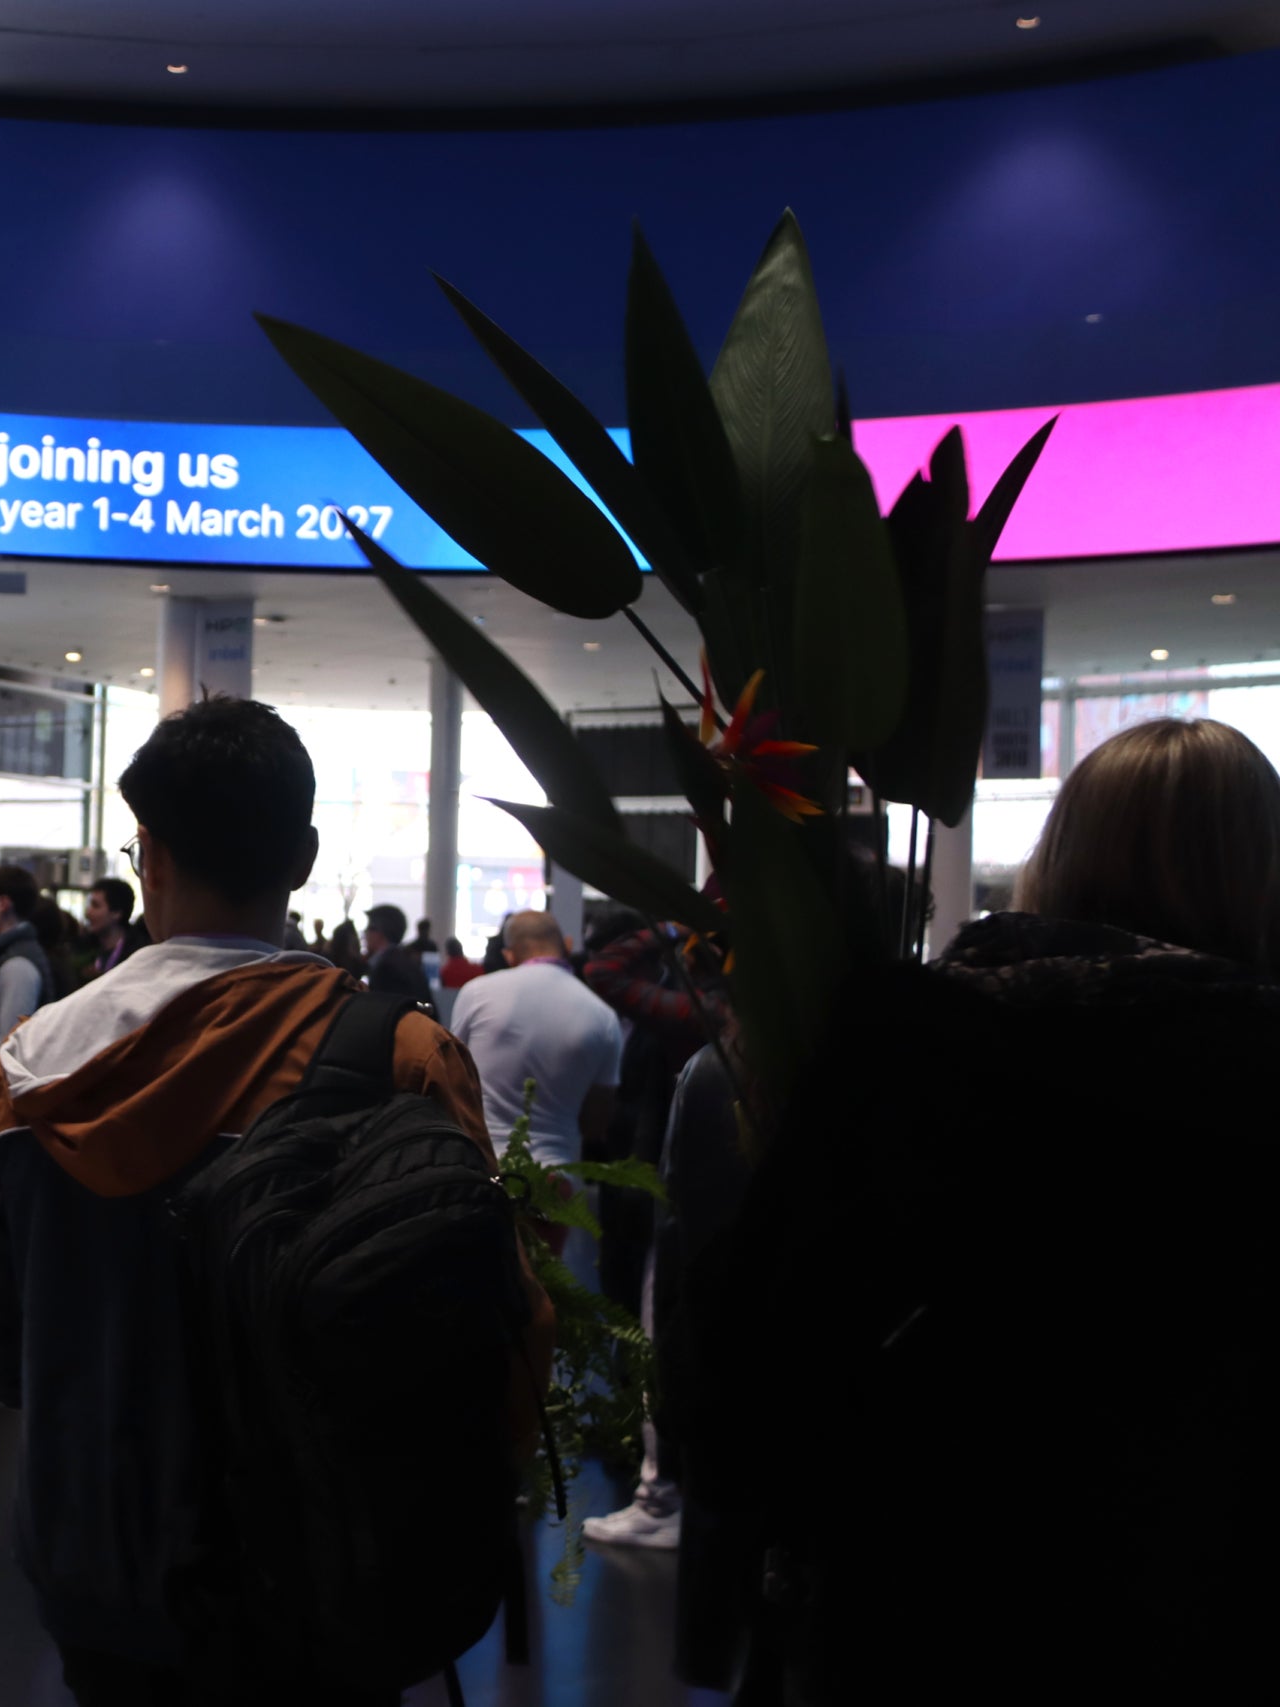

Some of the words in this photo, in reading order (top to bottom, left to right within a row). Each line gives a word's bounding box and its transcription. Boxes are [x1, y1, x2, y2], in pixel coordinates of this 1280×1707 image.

[178, 452, 239, 489] us
[92, 496, 155, 533] 1-4
[166, 499, 285, 538] March
